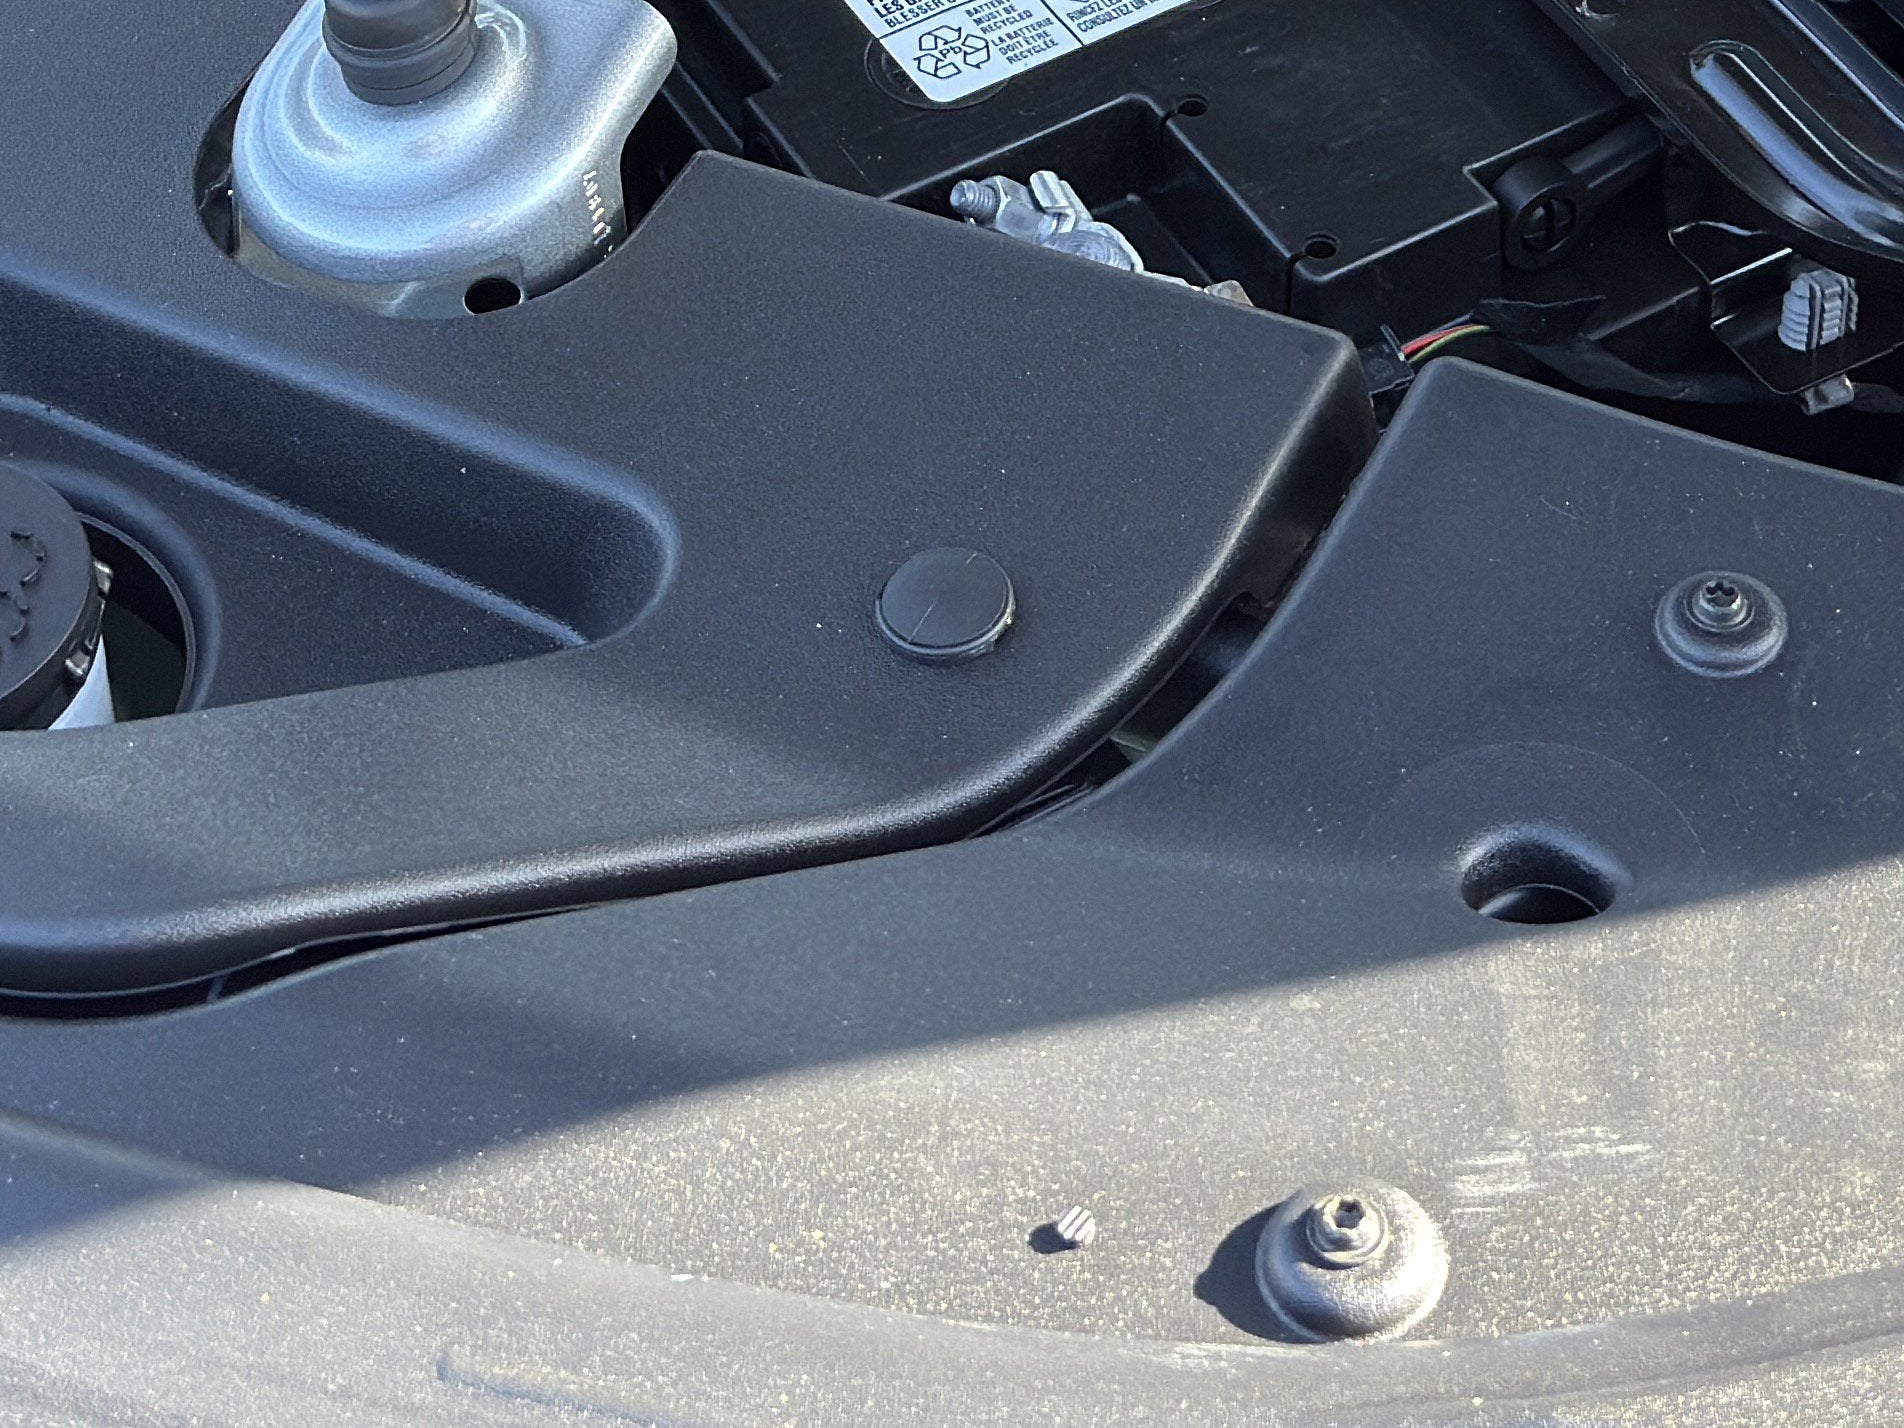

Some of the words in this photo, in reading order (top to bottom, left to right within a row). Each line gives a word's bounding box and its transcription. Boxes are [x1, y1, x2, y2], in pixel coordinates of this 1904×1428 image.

[874, 0, 904, 18] LES
[972, 10, 1002, 26] MUST
[1002, 4, 1017, 14] BE
[1077, 3, 1133, 32] CONSULTEZ
[980, 10, 1033, 35] RECYCLED
[991, 36, 1007, 47] LA
[1005, 17, 1054, 41] BATTERIE
[938, 46, 963, 59] Pb
[999, 41, 1023, 55] DOIT
